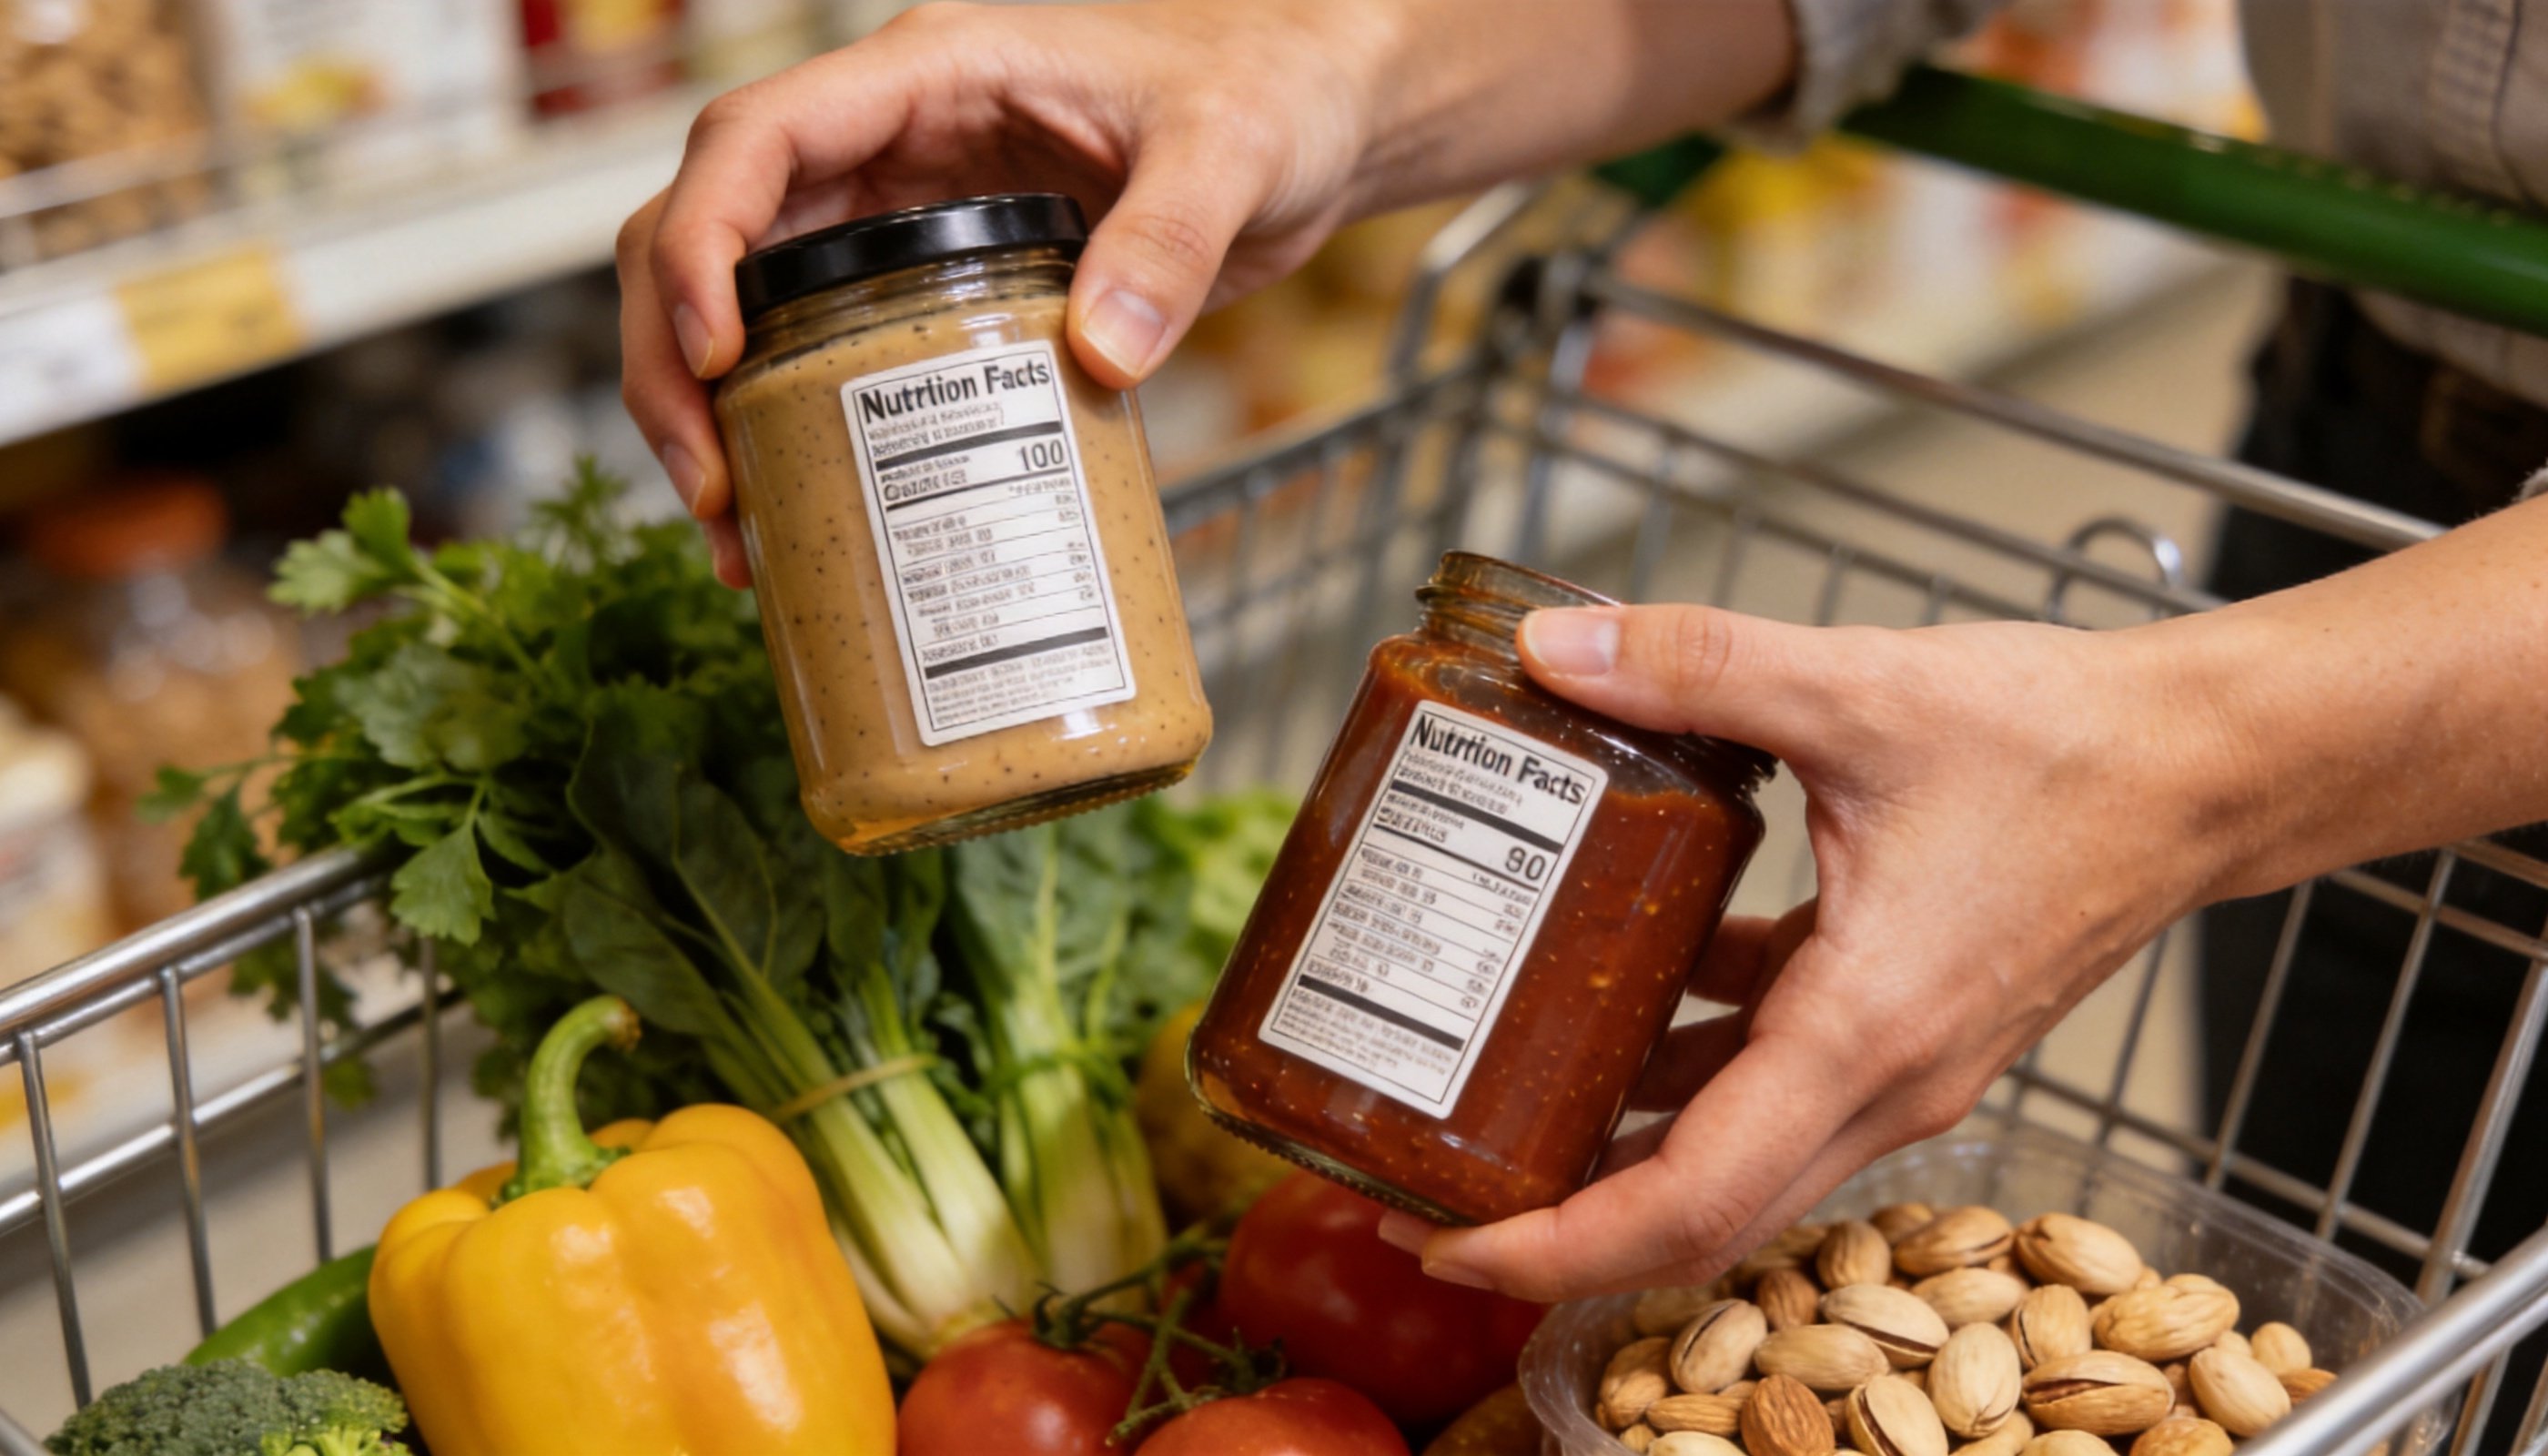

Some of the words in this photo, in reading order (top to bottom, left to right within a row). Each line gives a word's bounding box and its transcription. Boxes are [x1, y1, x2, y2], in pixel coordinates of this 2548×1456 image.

[983, 360, 1051, 395] Facts
[1019, 440, 1065, 472] 100
[1517, 755, 1587, 806] Facts
